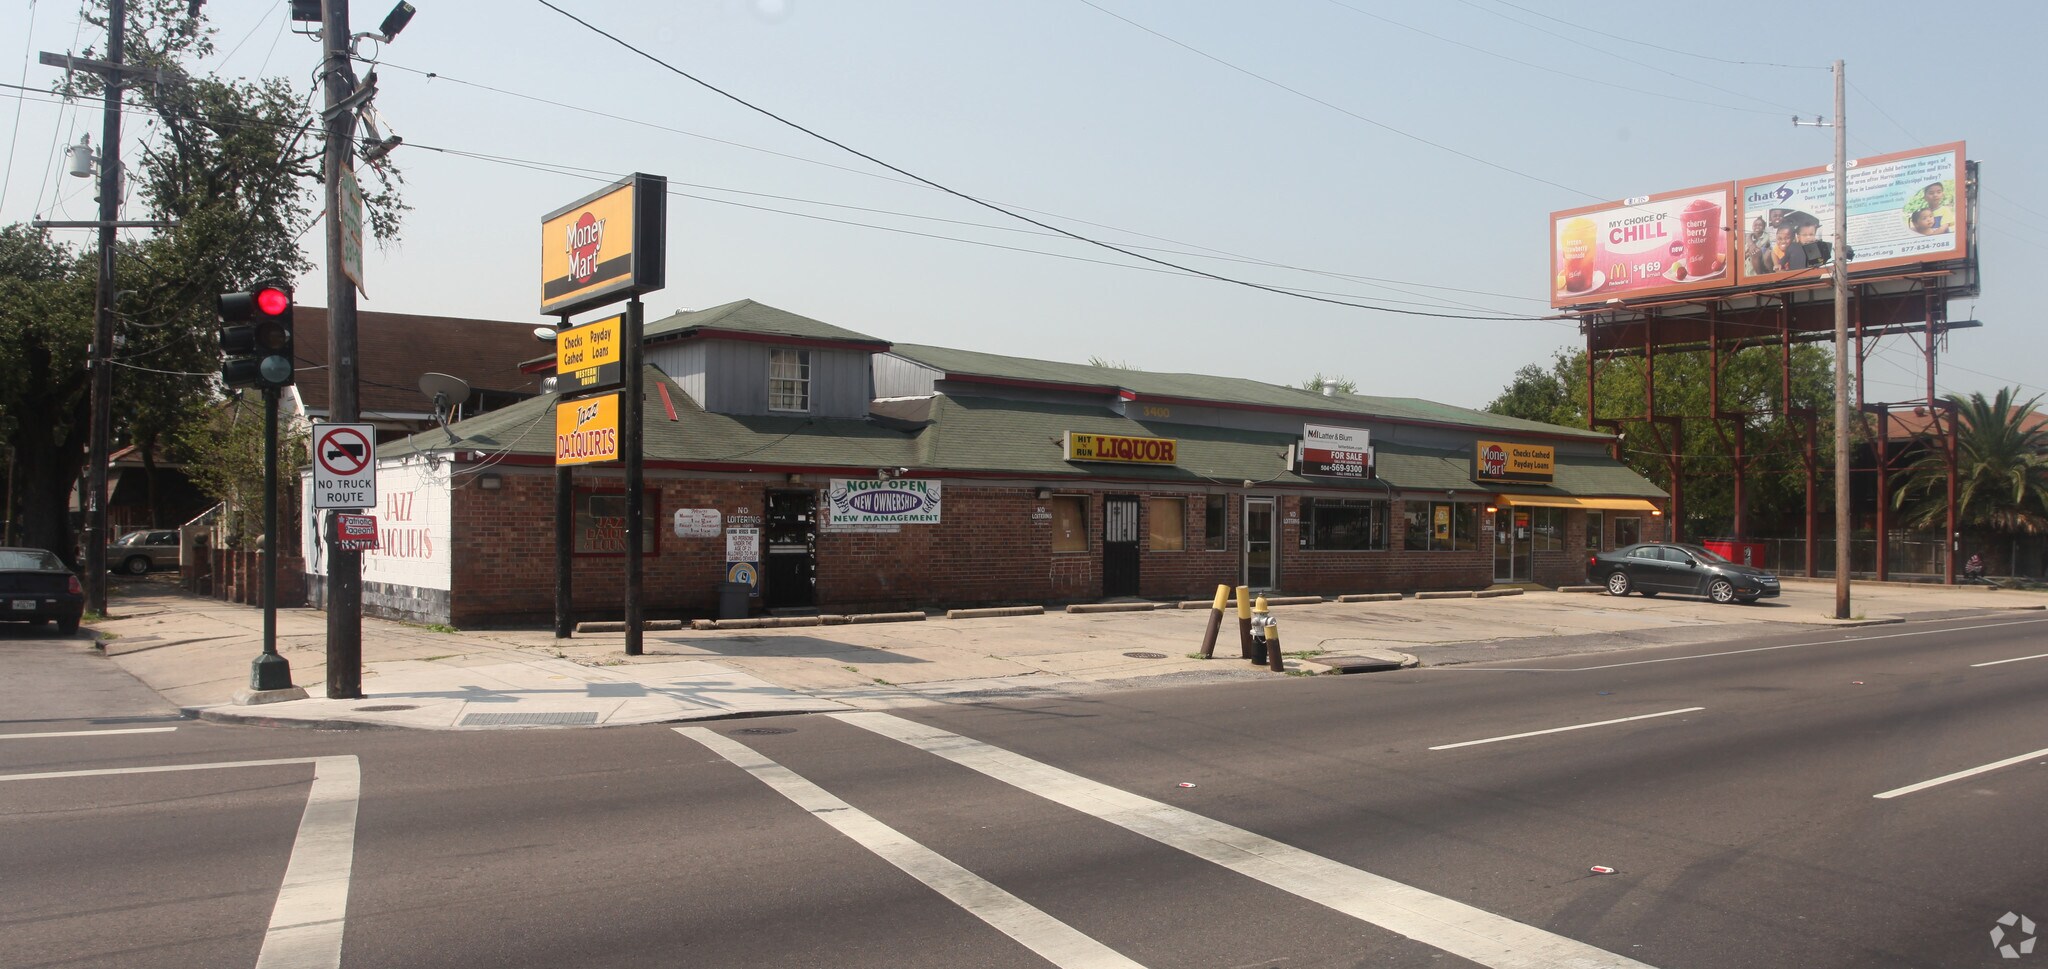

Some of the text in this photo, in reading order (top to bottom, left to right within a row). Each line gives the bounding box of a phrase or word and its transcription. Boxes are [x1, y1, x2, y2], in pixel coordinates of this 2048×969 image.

[1609, 212, 1668, 229] MY CHOICE OF
[1686, 219, 1707, 229] cherry
[566, 218, 606, 252] Money
[1609, 222, 1668, 245] CHILL
[1686, 227, 1708, 237] berry
[1687, 237, 1707, 245] chiller
[1672, 245, 1684, 253] new
[567, 249, 599, 282] Mart
[590, 327, 612, 344] Payday
[564, 335, 583, 350] Checks
[564, 348, 584, 365] Cashed
[592, 345, 609, 360] Loans
[575, 366, 598, 379] WESTERN
[581, 375, 598, 387] UNION
[574, 401, 599, 435] Jazz
[1077, 435, 1092, 443] HIT
[1308, 429, 1319, 439] NAI
[1319, 432, 1334, 440] Latter
[1339, 433, 1353, 442] Blum
[558, 428, 616, 460] DAIQUIRIS
[1095, 437, 1174, 462] LIQUOR
[1076, 448, 1093, 457] RUN
[1331, 451, 1363, 461] FOR SALE
[1481, 445, 1509, 466] Money
[1512, 449, 1550, 459] Checks Cashed
[1482, 461, 1505, 475] Mart
[1513, 459, 1549, 469] Payday Loans
[318, 479, 372, 489] NO TRUCK
[846, 480, 927, 494] NOW OPEN
[327, 492, 364, 502] ROUTE
[854, 494, 872, 511] NEW
[873, 492, 918, 512] OWNERSHIP
[384, 491, 414, 522] JAZZ
[737, 506, 749, 514] NO
[345, 518, 373, 526] Patriotic
[595, 517, 625, 529] JAZ
[727, 515, 761, 524] LOITERING
[862, 514, 938, 522] MANAGEMENT
[345, 526, 375, 536] Pageant
